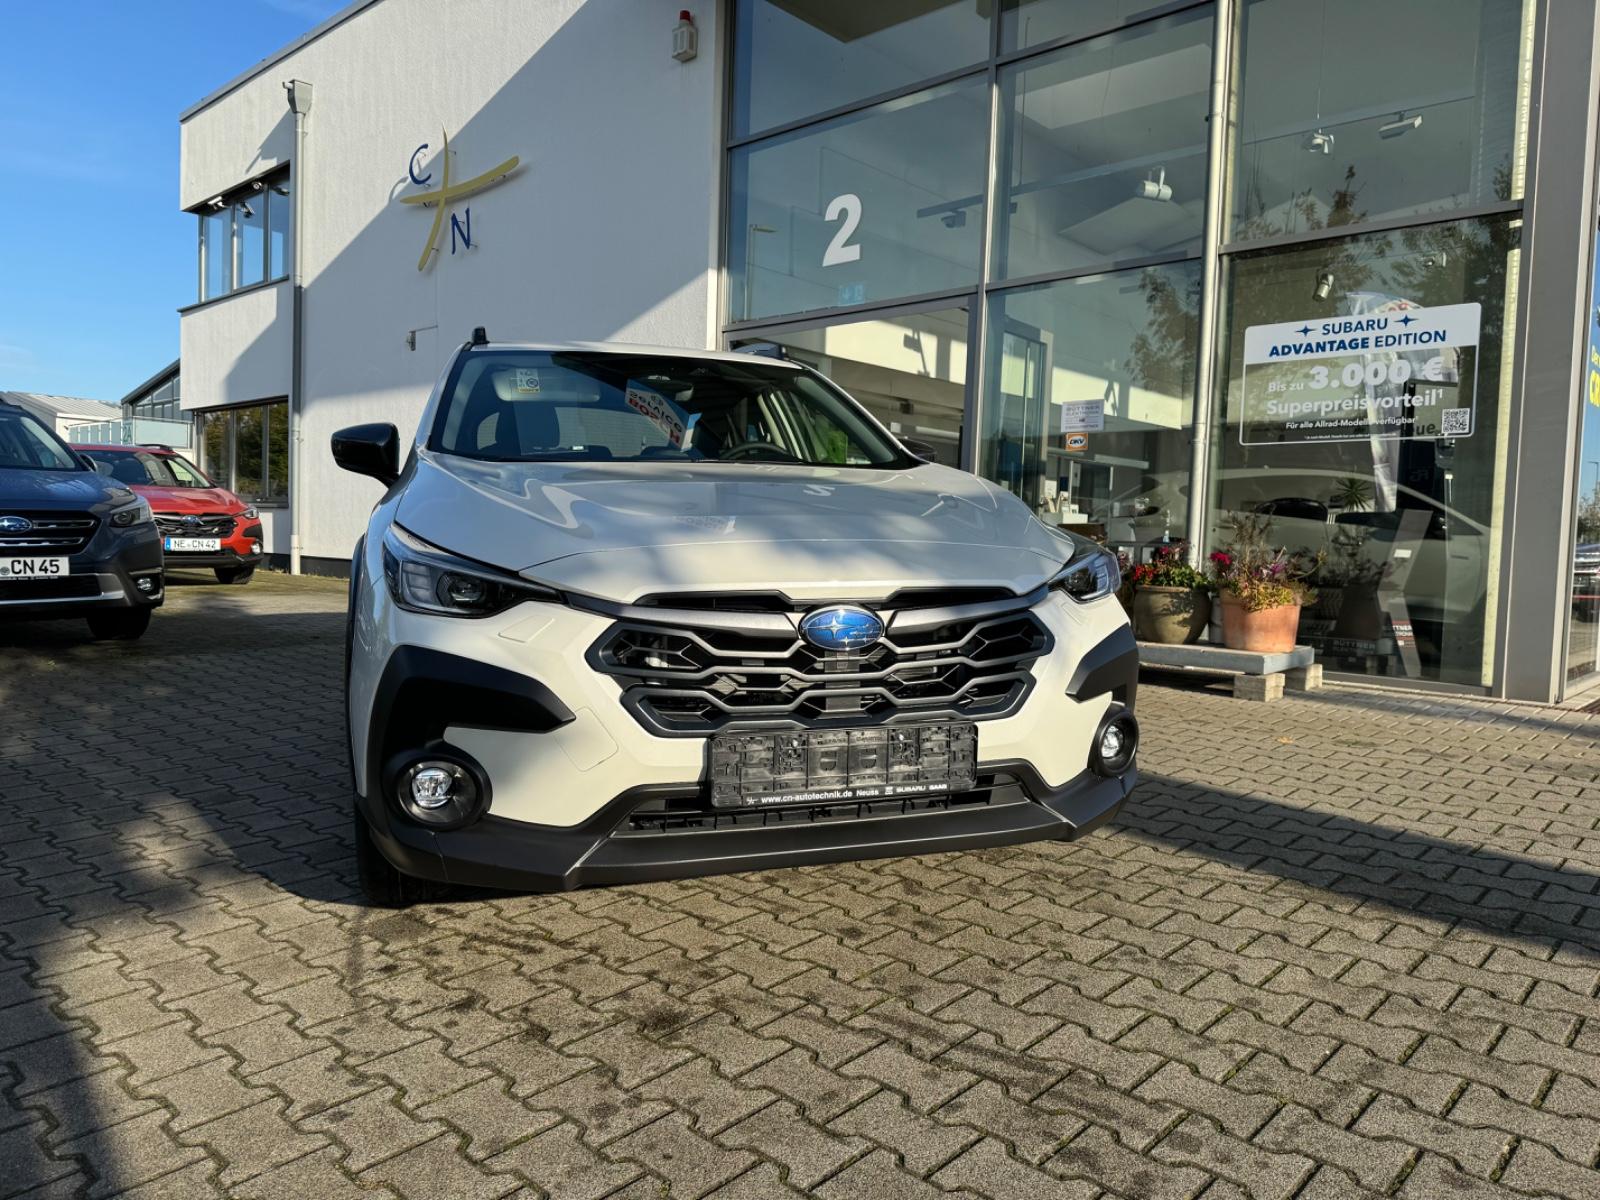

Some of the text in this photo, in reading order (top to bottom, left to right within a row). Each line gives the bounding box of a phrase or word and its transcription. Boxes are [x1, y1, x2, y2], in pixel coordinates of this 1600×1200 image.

[409, 143, 432, 185] C
[450, 207, 471, 255] N
[822, 193, 862, 267] 2
[1321, 318, 1388, 335] SUBARU
[1269, 330, 1447, 357] ADVANTAGE EDITION
[1268, 356, 1445, 392] Bis zu 3.000 €
[1286, 421, 1297, 429] Für
[1299, 420, 1313, 428] alle
[174, 539, 216, 549] NE CN 42
[11, 559, 60, 575] CN 45
[761, 790, 853, 804] www.cn-autotechnik.de
[856, 789, 879, 797] Neuss
[896, 784, 926, 793] SUBARU
